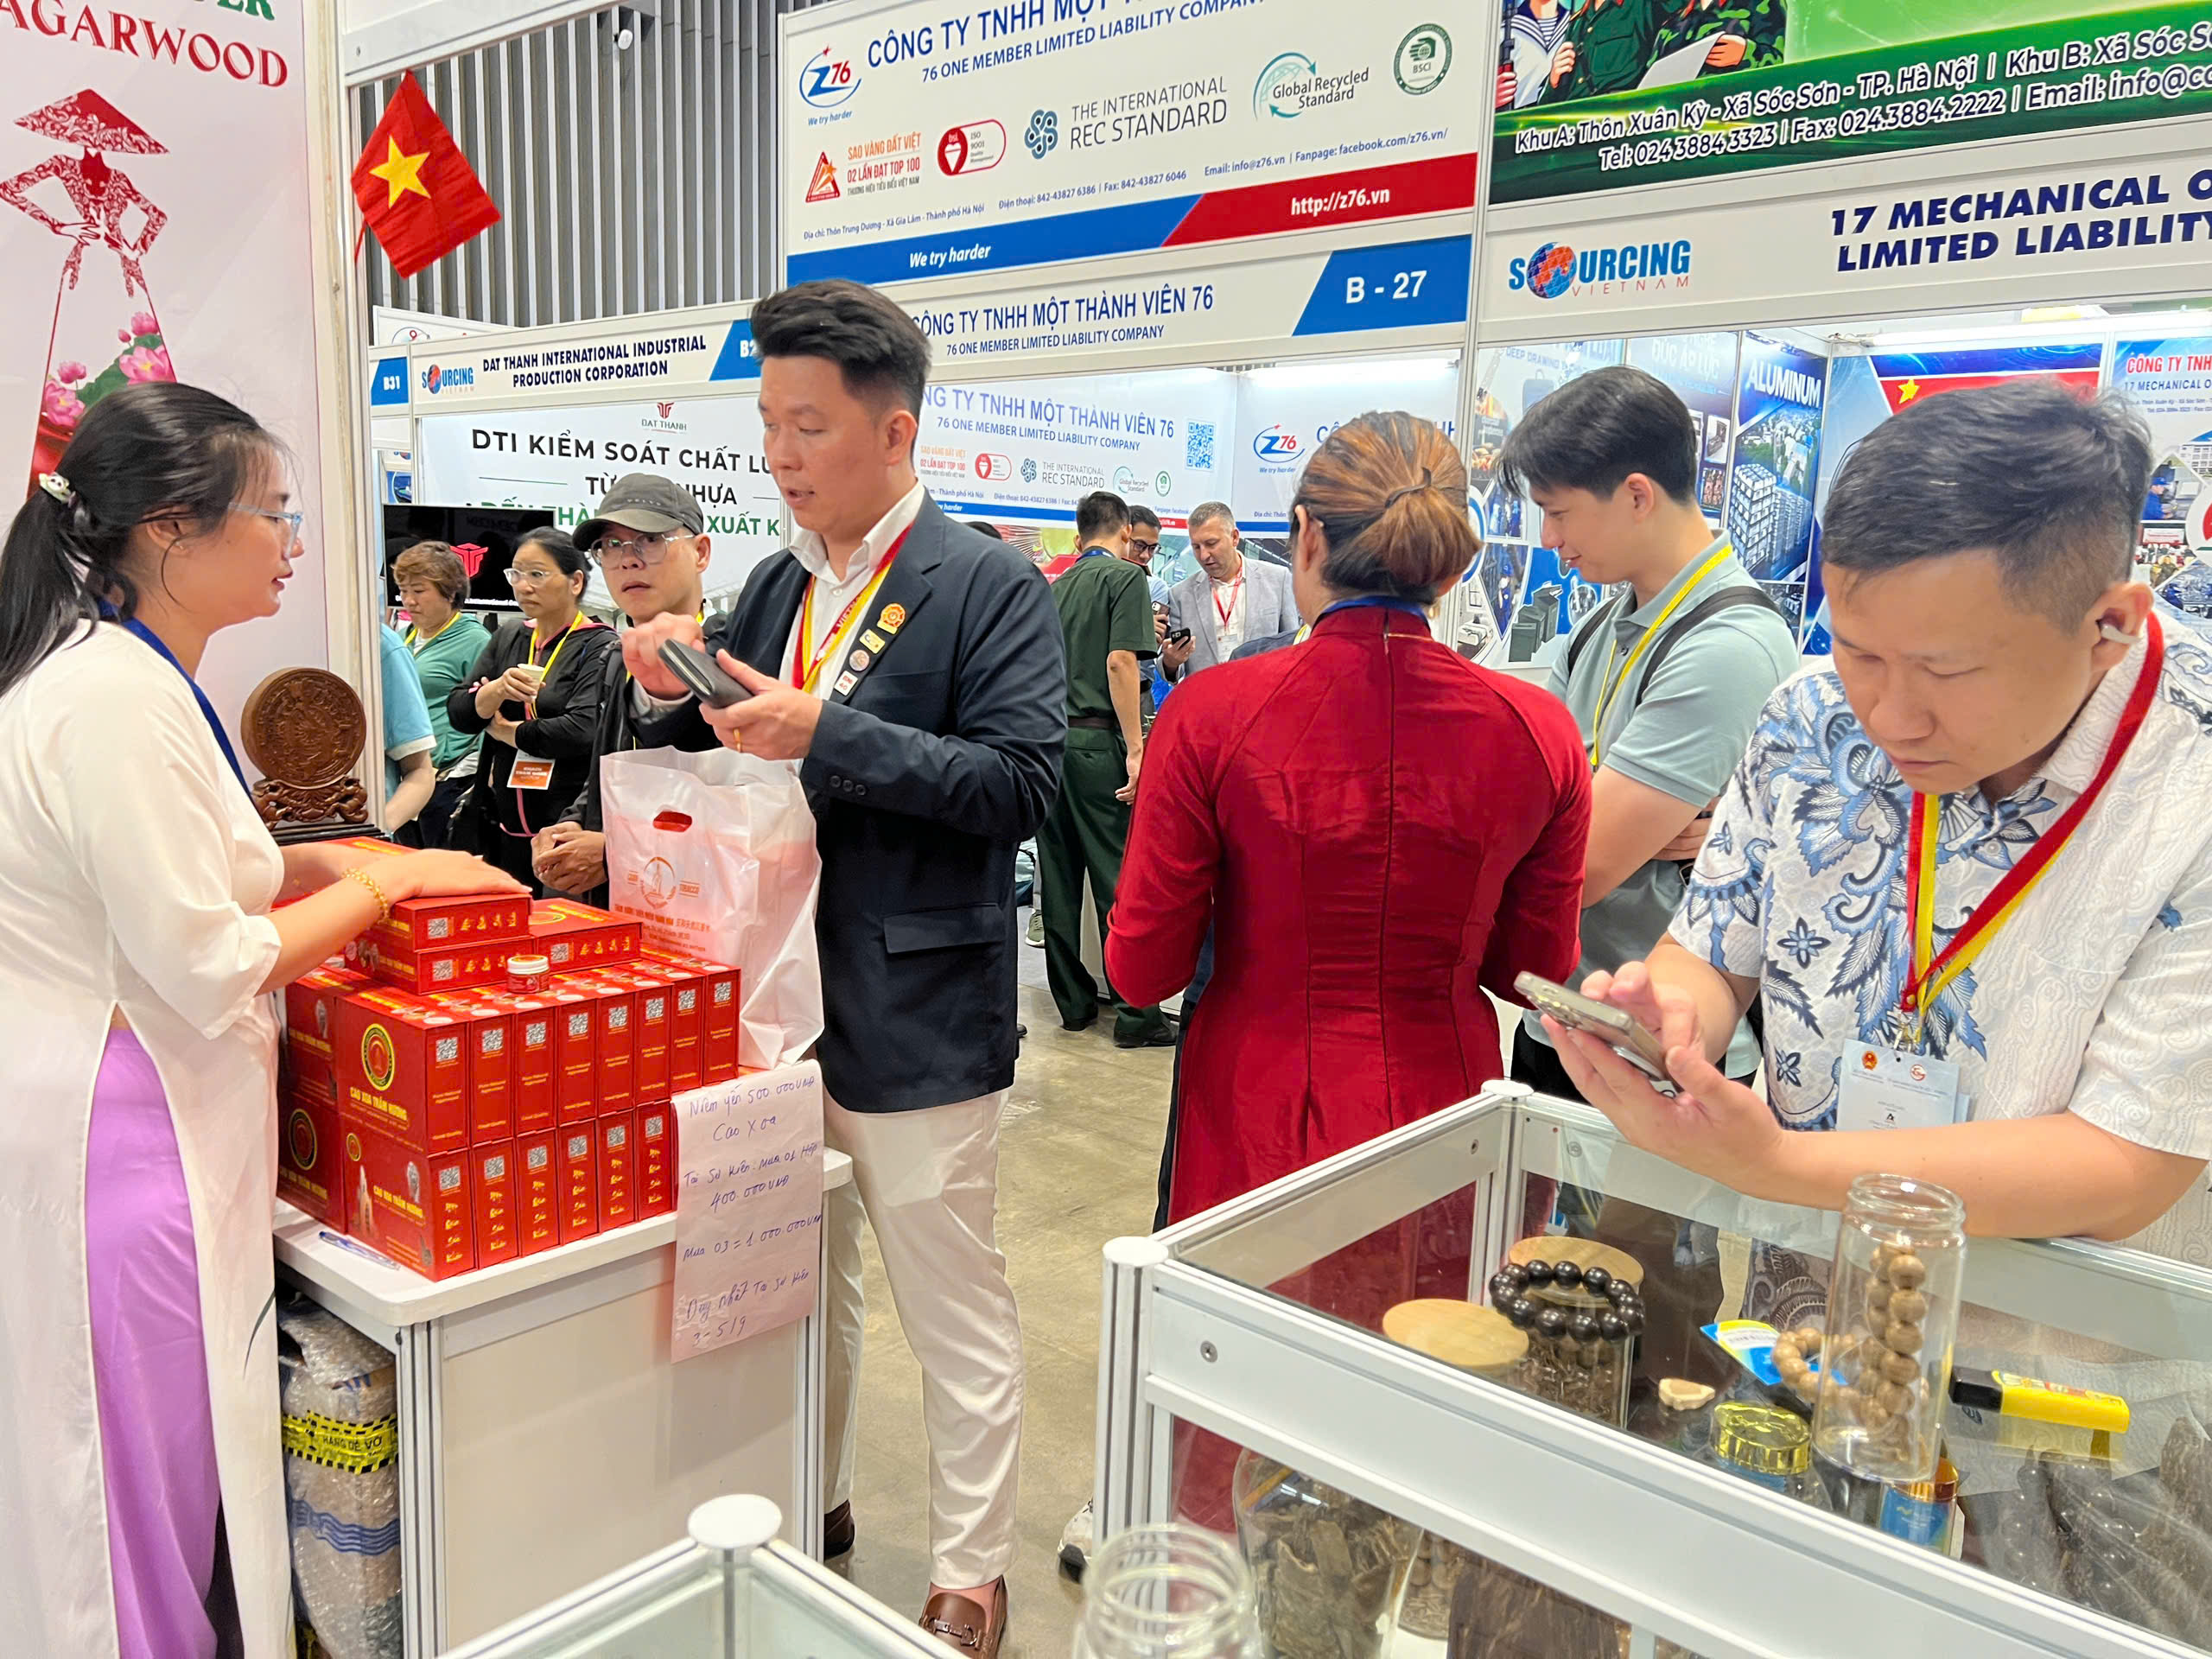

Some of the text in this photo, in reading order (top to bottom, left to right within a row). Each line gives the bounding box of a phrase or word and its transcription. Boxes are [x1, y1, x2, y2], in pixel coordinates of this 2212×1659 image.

[868, 29, 933, 68] CÔNG
[940, 15, 971, 50] TY
[977, 0, 1044, 41] TNHH
[922, 66, 938, 83] 76
[941, 58, 969, 78] ONE
[972, 42, 1032, 71] MEMBER
[1036, 27, 1096, 56] LIMITED
[1099, 6, 1175, 40] LIABILITY
[807, 60, 855, 98] Z76
[1273, 67, 1370, 99] Global Recycled
[1413, 62, 1431, 73] BSCI
[1071, 76, 1227, 122] THE INTERNATIONAL
[1298, 86, 1355, 109] Standard
[1517, 26, 2186, 153] Khu A: Thôn Xuân Kỳ Xã Sóc Sơn TP. Hà Nội Khu B: Xã Sóc
[808, 110, 853, 127] We try harder
[1071, 99, 1227, 149] REC STANDARD
[1599, 147, 1633, 171] Tel:
[1792, 116, 1837, 143] Fax:
[1840, 89, 2006, 135] 024.3884.2222
[2027, 73, 2107, 110] Email:
[848, 146, 862, 160] SAO
[864, 138, 885, 156] VÀNG
[903, 130, 921, 149] VIỆT
[970, 131, 982, 140] ISO
[971, 141, 985, 149] 9001
[842, 224, 860, 234] Trung
[896, 216, 906, 226] Gia
[926, 210, 946, 221] Thành
[962, 206, 972, 216] Hà
[972, 202, 985, 214] Nội
[1037, 188, 1075, 203] 842-43827
[1077, 185, 1096, 196] 6386
[1103, 180, 1120, 192] Fax:
[1121, 174, 1163, 189] 842-43827
[1166, 170, 1186, 181] 6046
[1205, 164, 1230, 176] Email:
[1231, 154, 1285, 173] info@z76.vn
[1295, 147, 1338, 162] Fanpage:
[1338, 127, 1449, 156] facebook.com/z76.vn/
[847, 169, 856, 183] 02
[890, 160, 905, 176] TOP
[906, 156, 920, 172] 100
[1290, 188, 1390, 217] http://z76.vn
[1832, 205, 1878, 236] 17
[1887, 175, 2170, 231] MECHANICAL
[909, 243, 991, 268] We try harder
[1838, 232, 1999, 272] LIMITED
[1346, 270, 1427, 304] B 27
[1571, 275, 1690, 297] VIETNAM
[959, 309, 979, 334] TY
[983, 303, 1027, 330] TNHH
[1033, 296, 1070, 331] MỘT
[1076, 290, 1136, 322] THÀNH
[1142, 283, 1186, 315] VIÊN
[1192, 284, 1213, 311] 76
[483, 334, 707, 372] DAT THANH INTERNATIONAL INDUSTRIAL
[947, 325, 1165, 356] 76 ONE MEMBER LIMITED LIABILITY COMPANY
[513, 359, 668, 387] PRODUCTION CORPORATION
[2127, 353, 2183, 373] CÔNG TY
[383, 375, 401, 391] B31
[1748, 359, 1821, 409] ALUMINUM
[2138, 379, 2201, 391] MECHANICAL
[923, 385, 1174, 438] NG TY TNHH MỘT THÀNH VIÊN 76
[937, 416, 1141, 451] 76 ONE MEMBER LIMITED LIABILITY COMPANY
[1260, 434, 1297, 454] Z76
[472, 429, 517, 452] DTI
[529, 429, 594, 459] KIỂM
[605, 440, 671, 465] SOÁT
[678, 445, 741, 471] CHẤT
[1042, 472, 1105, 489] REC STANDARD
[1043, 461, 1105, 476] THE INTERNATIONAL
[707, 511, 761, 536] XUẤT
